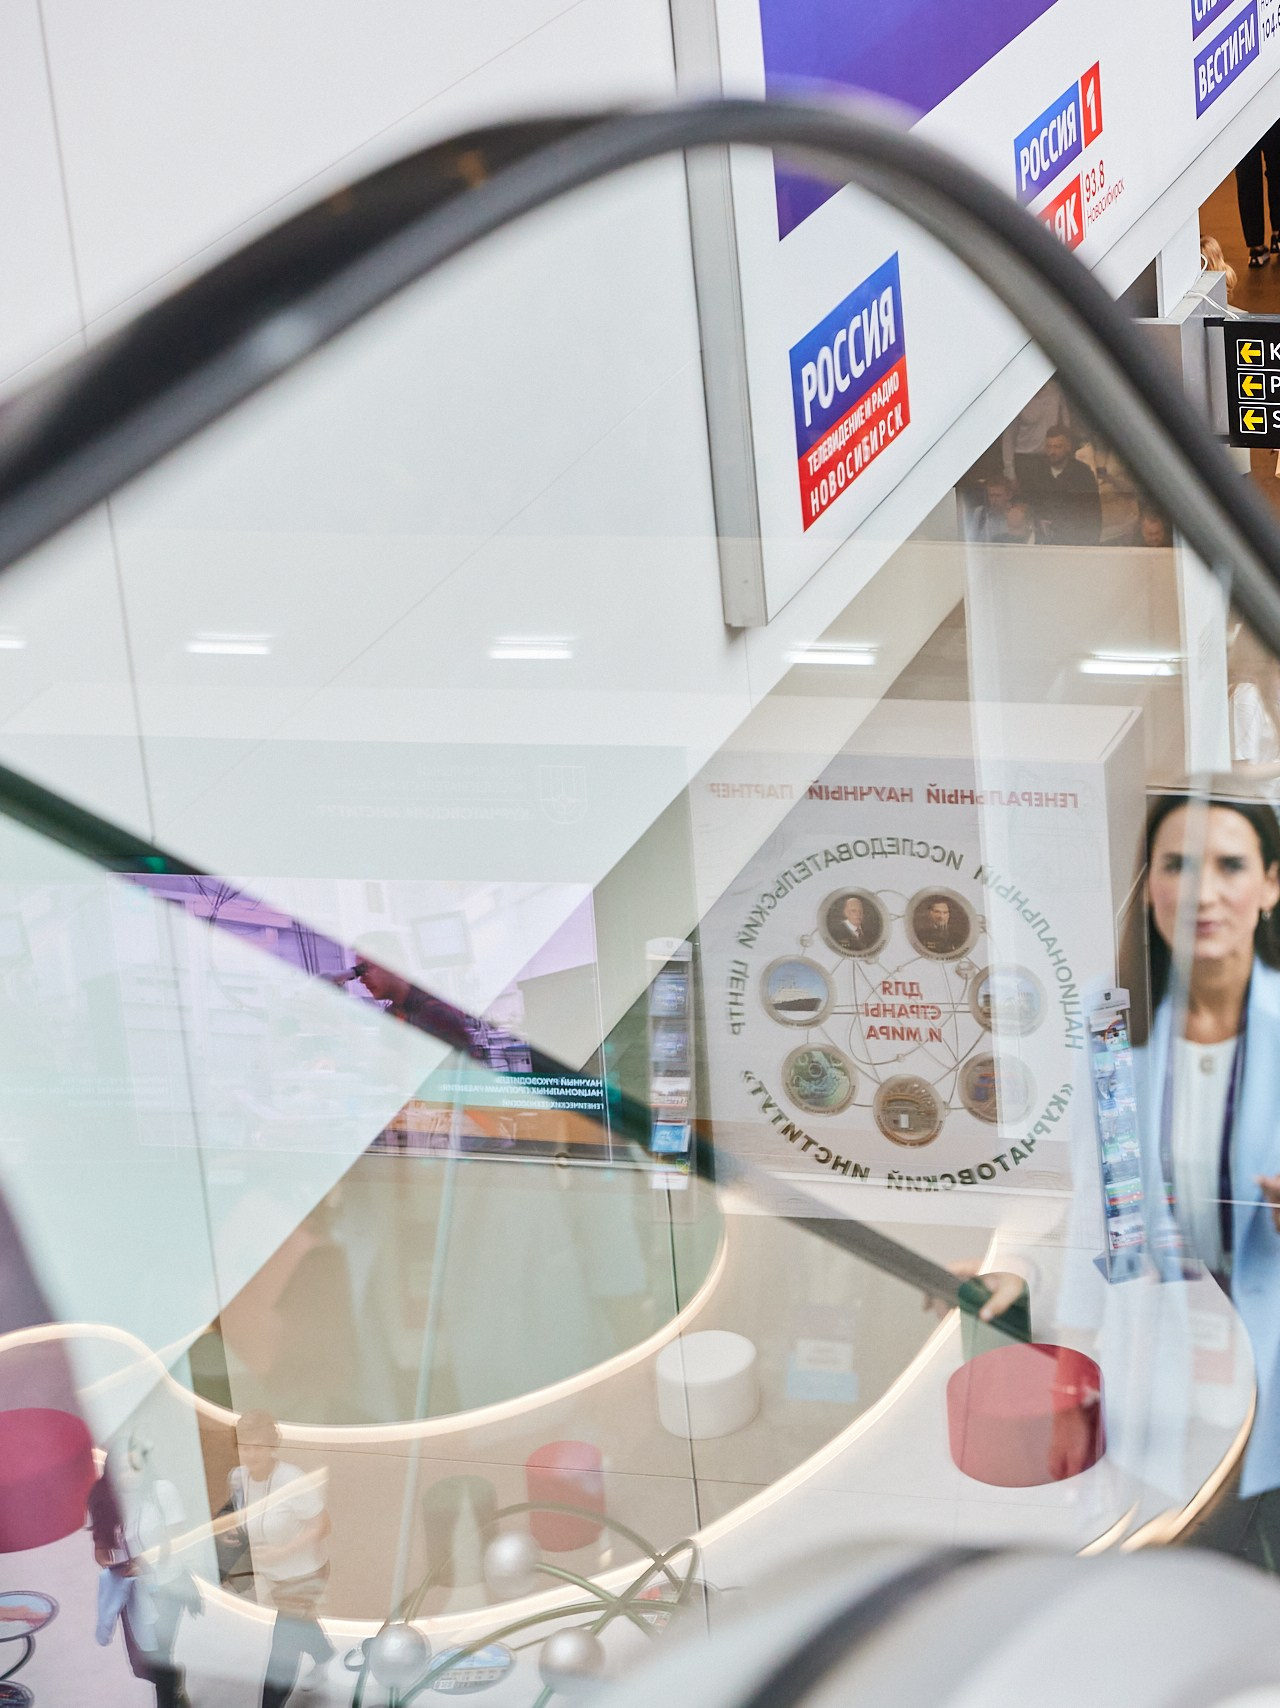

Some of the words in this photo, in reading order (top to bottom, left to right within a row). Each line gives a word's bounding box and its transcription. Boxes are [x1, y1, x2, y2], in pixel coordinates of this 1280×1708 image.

[1019, 101, 1077, 192] РОССИЯ
[1086, 76, 1098, 132] 1
[1085, 159, 1105, 203] 93.8
[1086, 178, 1125, 228] Новосибирск
[801, 285, 896, 428] РОССИЯ
[808, 405, 866, 476] ТЕЛЕВИДЕНИЕ
[871, 371, 900, 413] РАДИО
[810, 402, 904, 517] НОВОСИБИРСК
